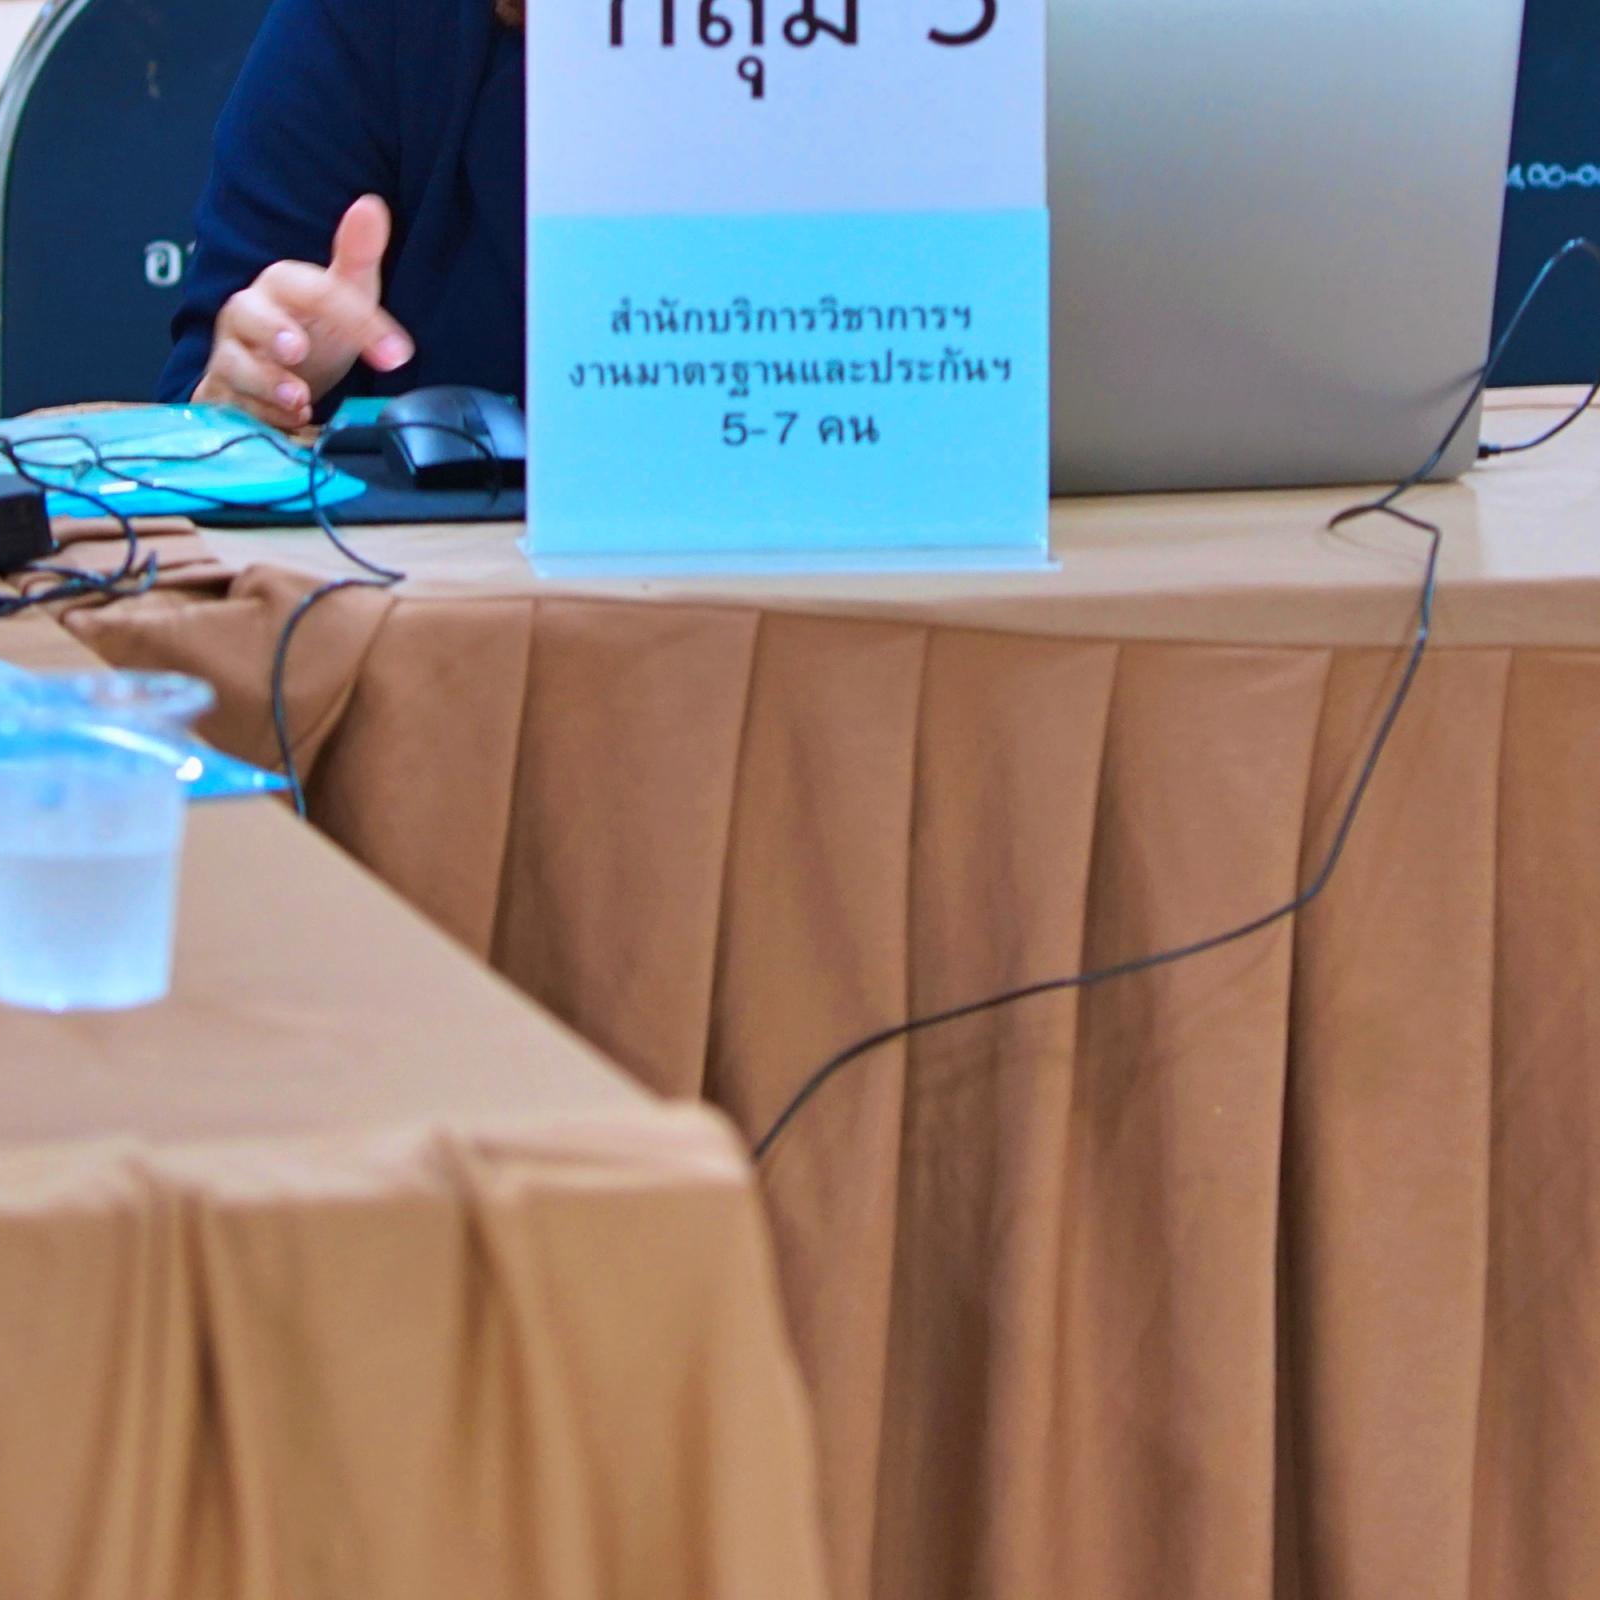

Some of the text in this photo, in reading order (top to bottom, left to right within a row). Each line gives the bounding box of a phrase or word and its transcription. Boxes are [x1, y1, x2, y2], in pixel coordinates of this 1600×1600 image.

[610, 294, 973, 336] สำนักบริการวิชาการฯ
[568, 345, 1013, 400] งานมาตรฐานและประกันฯ
[720, 409, 882, 448] 5-7 คน
